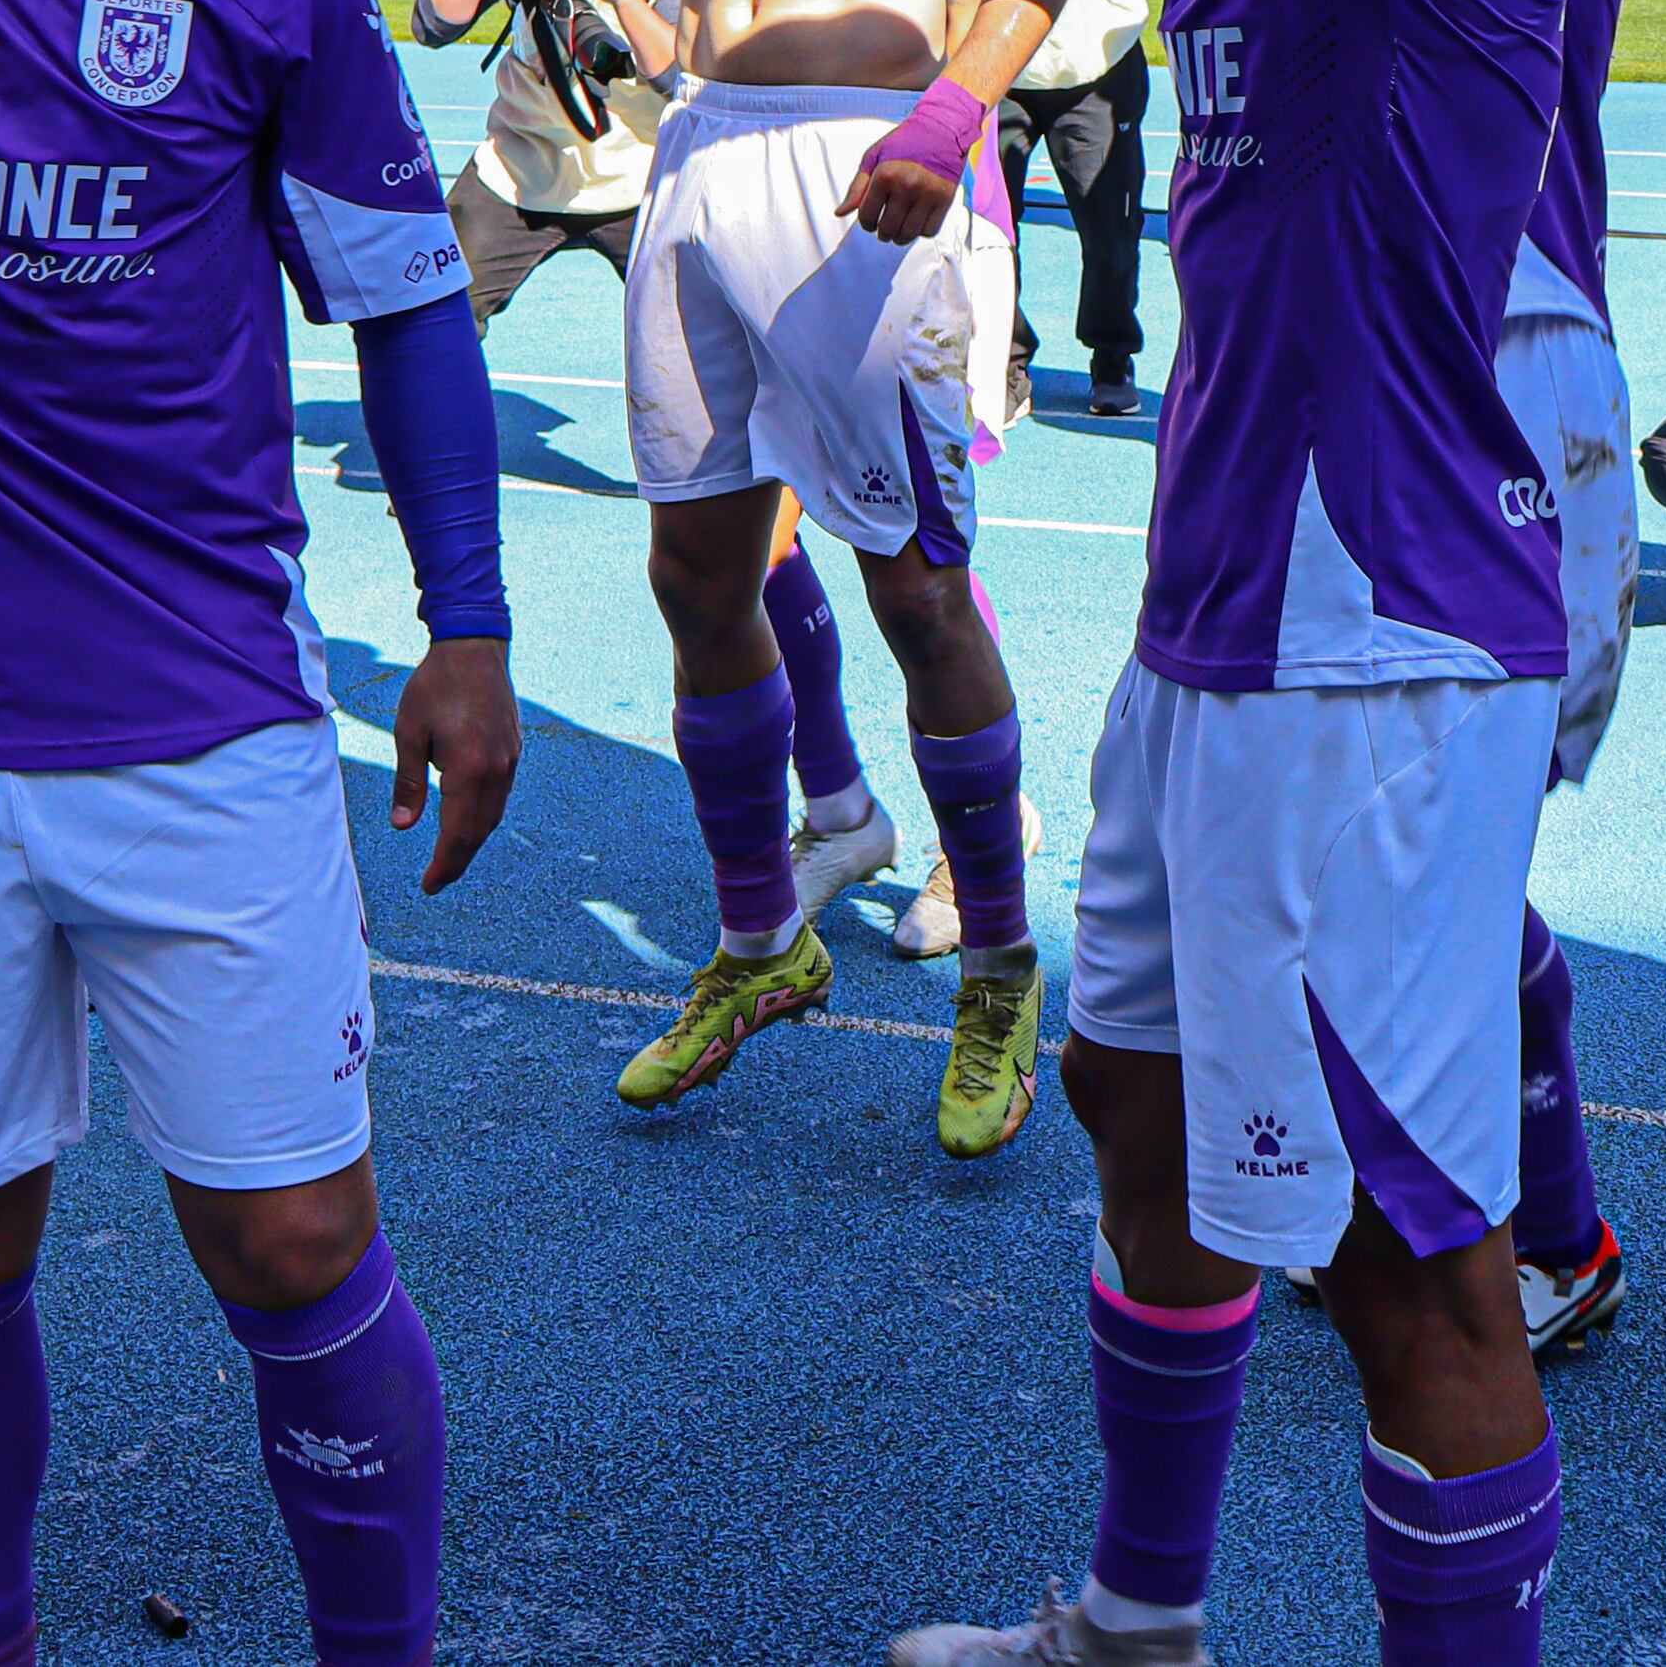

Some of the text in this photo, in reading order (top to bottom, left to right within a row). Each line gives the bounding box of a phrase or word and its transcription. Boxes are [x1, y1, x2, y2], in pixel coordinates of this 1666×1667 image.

[82, 56, 178, 103] CONCEPCION
[853, 491, 904, 506] KELME
[803, 602, 831, 633] 19
[1235, 1159, 1310, 1177] KELME
